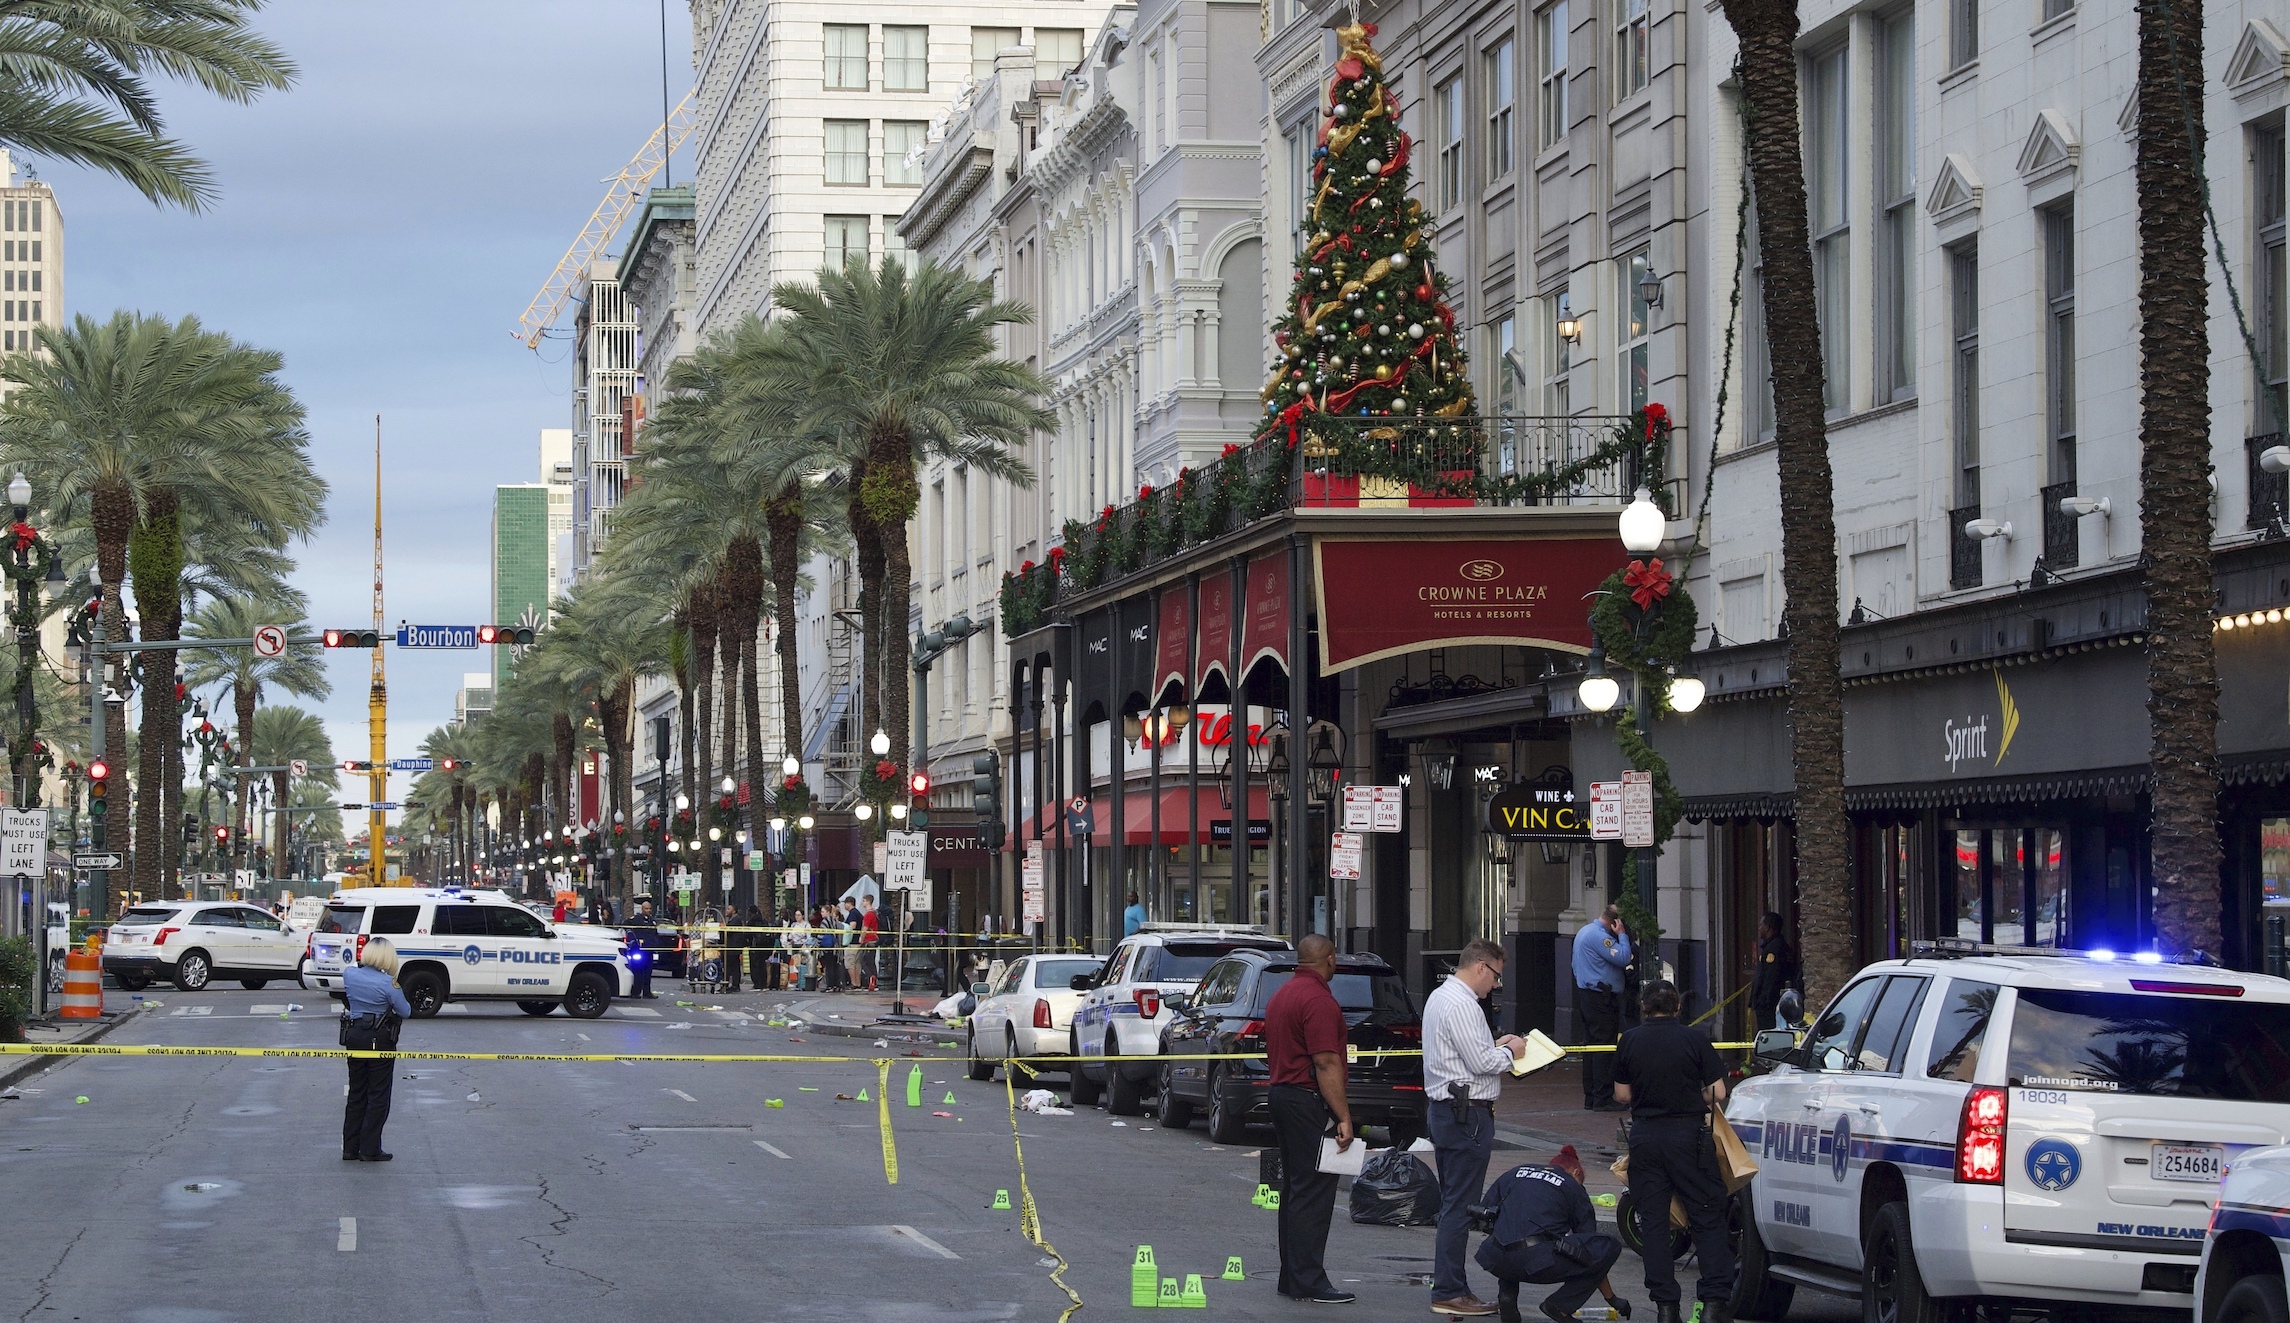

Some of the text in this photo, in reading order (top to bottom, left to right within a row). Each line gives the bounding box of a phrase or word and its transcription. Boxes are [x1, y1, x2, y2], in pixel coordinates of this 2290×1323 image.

[1418, 586, 1487, 601] CROWNE
[1434, 610, 1472, 619] HOTELS
[1486, 610, 1532, 619] RESORTS
[408, 625, 472, 647] Bourbon
[1130, 624, 1148, 643] MAC
[1088, 636, 1108, 655] MAC
[1944, 714, 1987, 774] Sprint
[396, 760, 432, 770] Dauphine
[1474, 766, 1500, 782] MAC
[1624, 773, 1631, 782] NO
[1346, 790, 1353, 798] NO
[1374, 790, 1382, 798] NO
[1535, 790, 1560, 802] WINE
[1592, 788, 1620, 798] NO PARKING
[373, 802, 397, 810] Burgundy
[1076, 801, 1083, 810] P
[1600, 804, 1614, 812] CAB
[9, 817, 41, 826] TRUCKS
[1502, 807, 1548, 828] VIN
[1596, 816, 1618, 825] STAND
[2, 829, 45, 839] MUST USE
[1214, 826, 1266, 834] TRUE IGION
[894, 838, 920, 847] TRUCKS
[934, 838, 990, 852] CENT
[12, 844, 34, 853] LEFT
[10, 858, 34, 868] LANE
[896, 862, 915, 870] LEFT
[895, 875, 915, 883] LANE
[500, 949, 560, 964] POLICE
[507, 978, 550, 986] NEW ORLEANS
[2022, 1075, 2119, 1090] joinnopd.org
[2019, 1090, 2068, 1104] 18034
[1764, 1120, 1818, 1166] POLICE
[2169, 1146, 2202, 1154] Louisiana
[2165, 1156, 2218, 1174] 254684
[1544, 1174, 1563, 1186] LAB
[997, 1194, 1007, 1203] 25
[1270, 1196, 1278, 1204] 43
[1774, 1200, 1810, 1227] NEW ORLEANS
[2097, 1222, 2208, 1239] NEW ORLEANS
[1139, 1251, 1151, 1263] 31
[1228, 1262, 1240, 1273] 26
[1163, 1284, 1176, 1296] 28
[1188, 1281, 1199, 1293] 21
